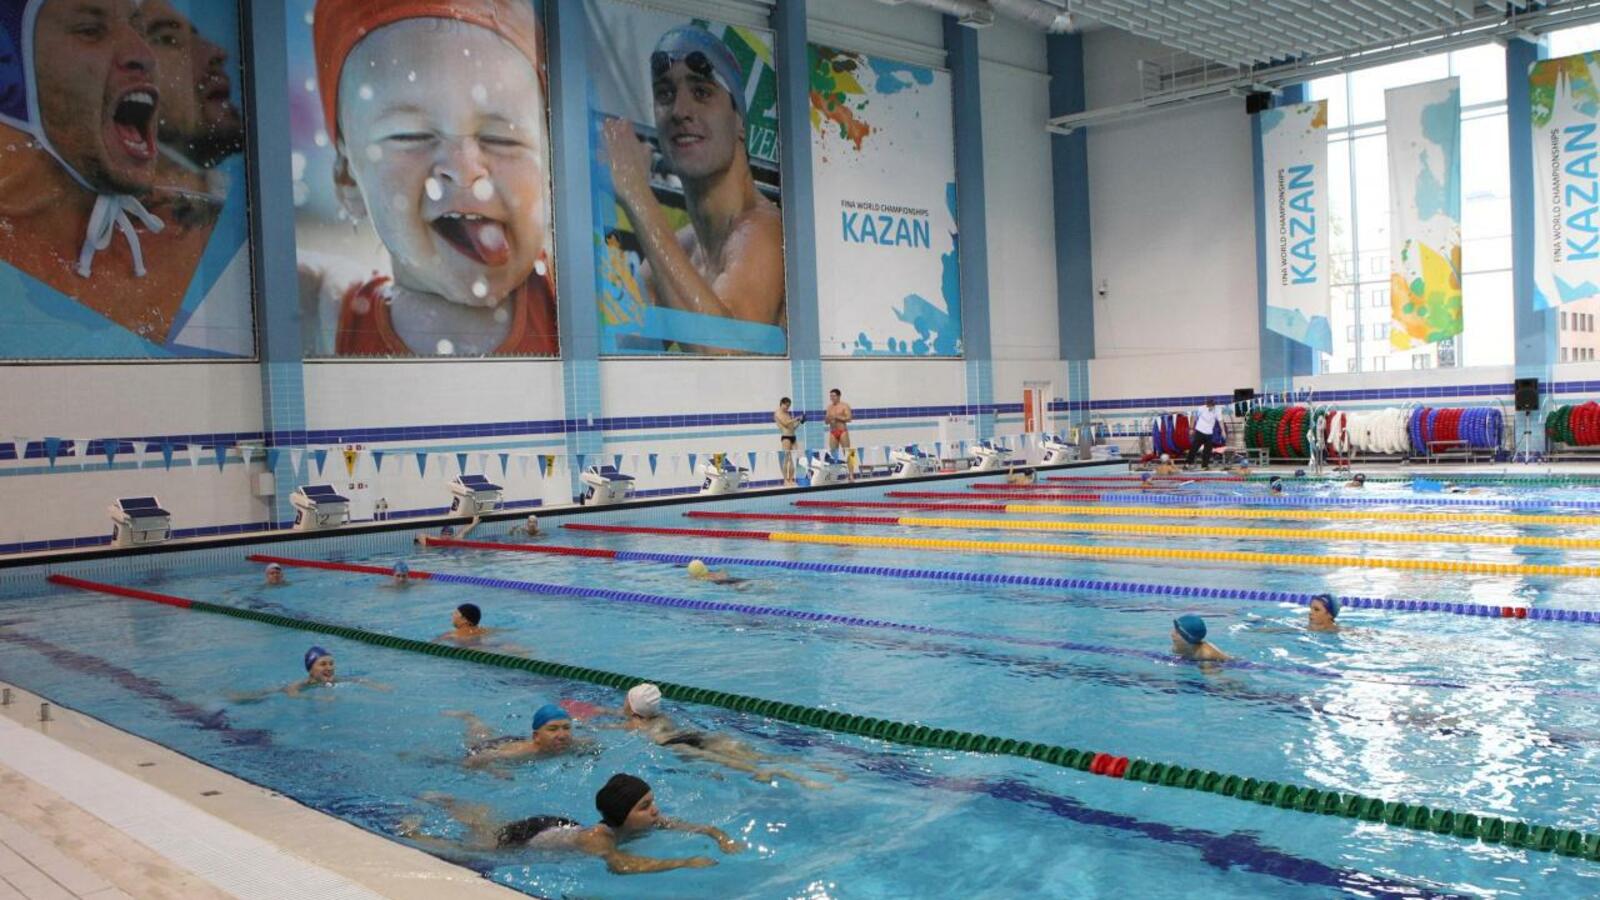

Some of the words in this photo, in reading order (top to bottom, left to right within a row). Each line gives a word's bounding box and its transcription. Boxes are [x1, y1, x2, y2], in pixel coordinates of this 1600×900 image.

[1550, 128, 1561, 204] CHAMPIONSHIPS
[841, 199, 856, 208] FINA
[856, 201, 881, 211] WORLD
[881, 204, 929, 216] CHAMPIONSHIPS
[1278, 168, 1287, 235] CHAMPIONSHIPS
[1562, 123, 1600, 262] KAZAN
[841, 211, 930, 248] KAZAN
[1287, 164, 1317, 285] KAZAN
[1551, 207, 1561, 241] WORLD
[1279, 237, 1287, 267] WORLD
[1551, 242, 1561, 263] FINA
